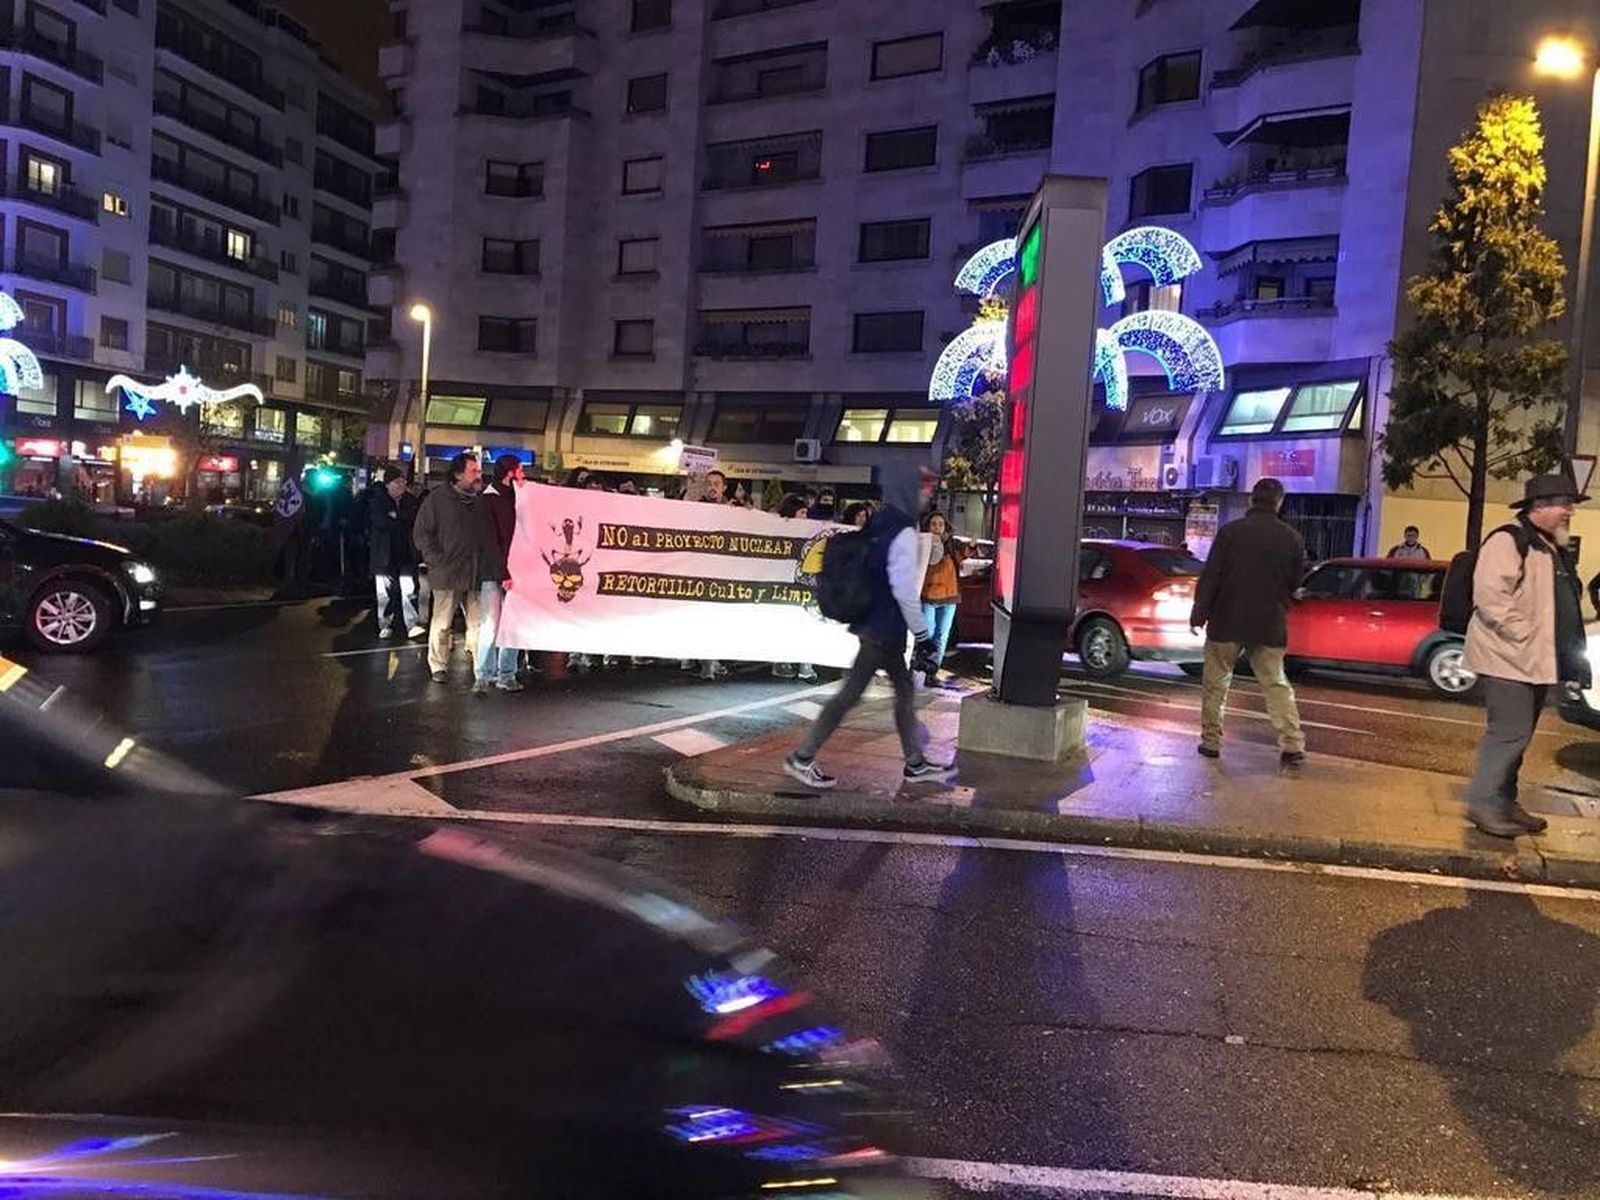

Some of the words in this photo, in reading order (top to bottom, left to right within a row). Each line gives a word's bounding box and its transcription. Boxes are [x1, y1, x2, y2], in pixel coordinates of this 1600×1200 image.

[601, 525, 629, 547] NO
[632, 532, 650, 548] al
[656, 533, 725, 550] PROYECTO
[729, 537, 793, 556] NUCLEAR
[603, 574, 705, 598] RETORTILLO
[708, 581, 753, 600] Culto
[754, 588, 767, 604] y
[771, 585, 813, 606] Limp
